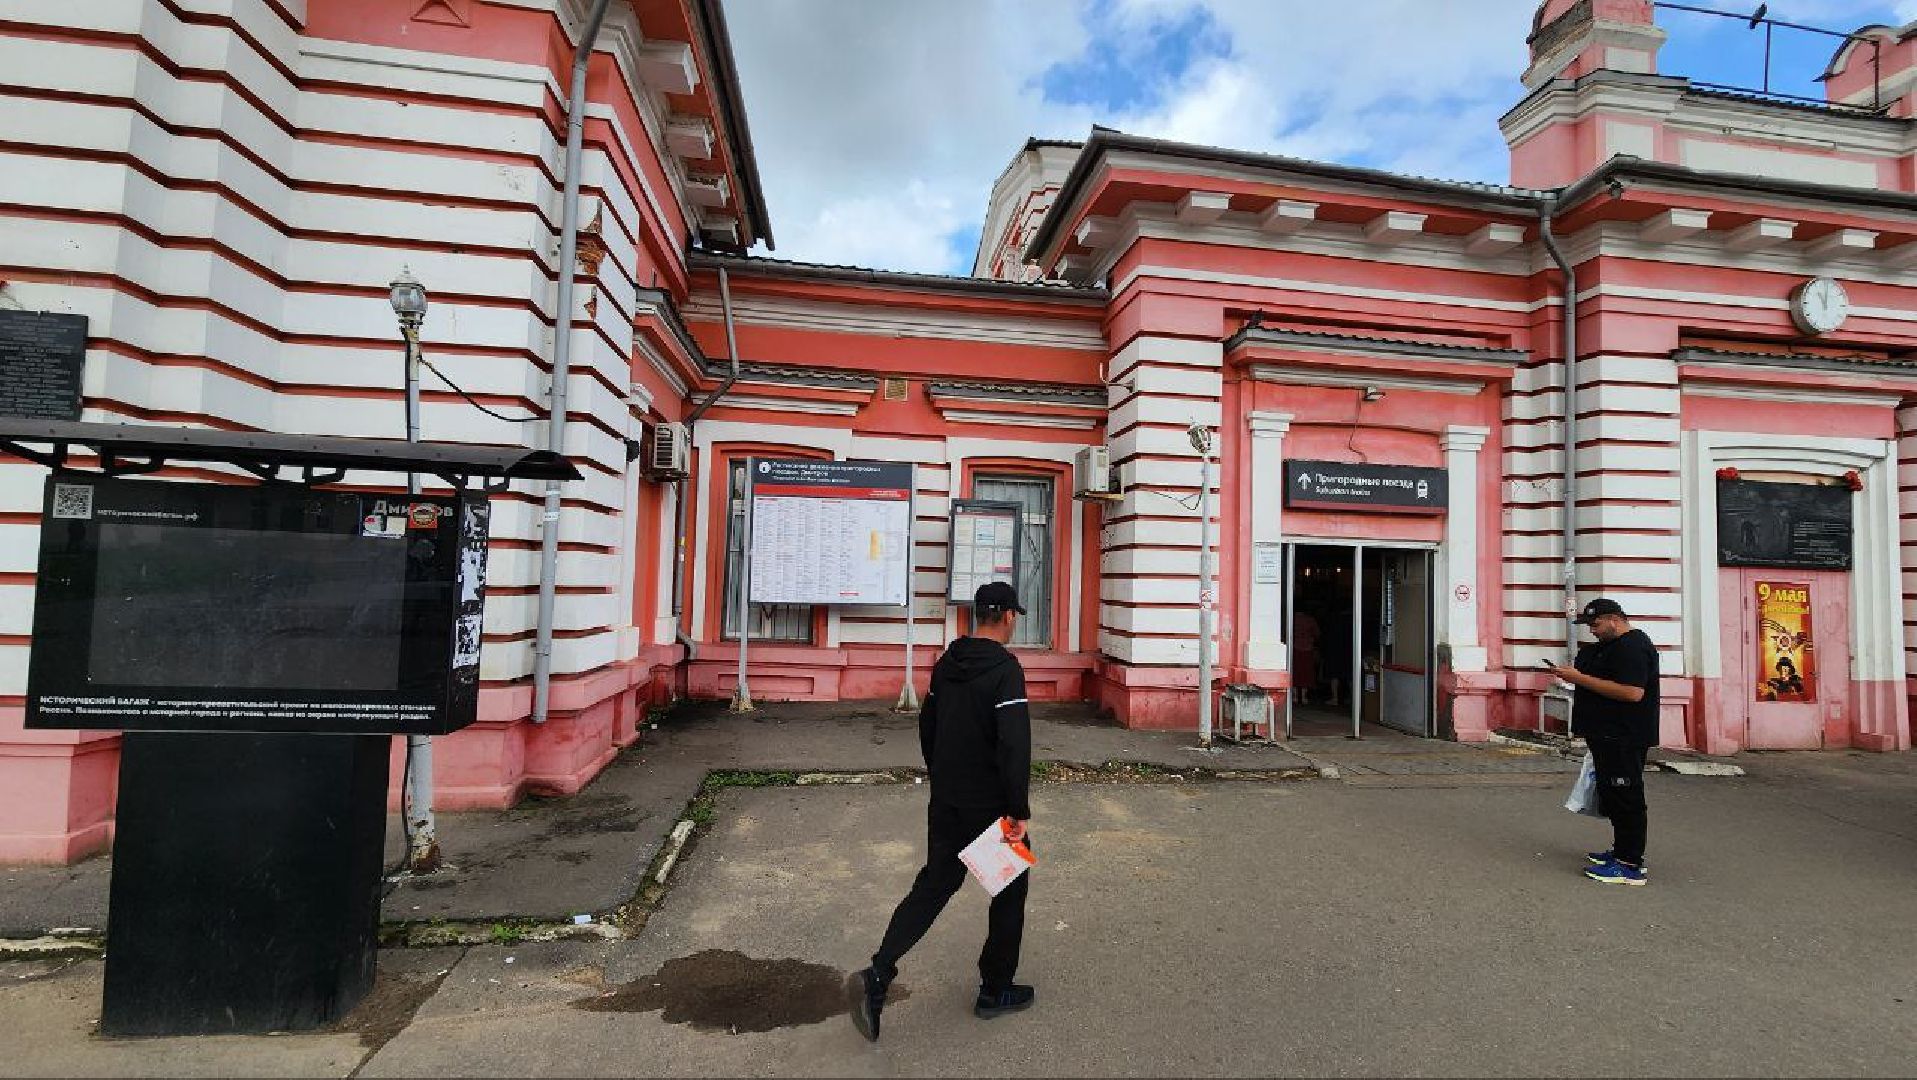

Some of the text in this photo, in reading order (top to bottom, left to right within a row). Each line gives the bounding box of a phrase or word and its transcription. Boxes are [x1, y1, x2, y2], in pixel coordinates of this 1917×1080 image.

[1315, 473, 1414, 489] Пригородные поезда
[372, 499, 454, 517] Дмиов
[1758, 583, 1807, 602] 9 мая
[39, 696, 116, 705] ИСТОРИЧЕСКИЙ
